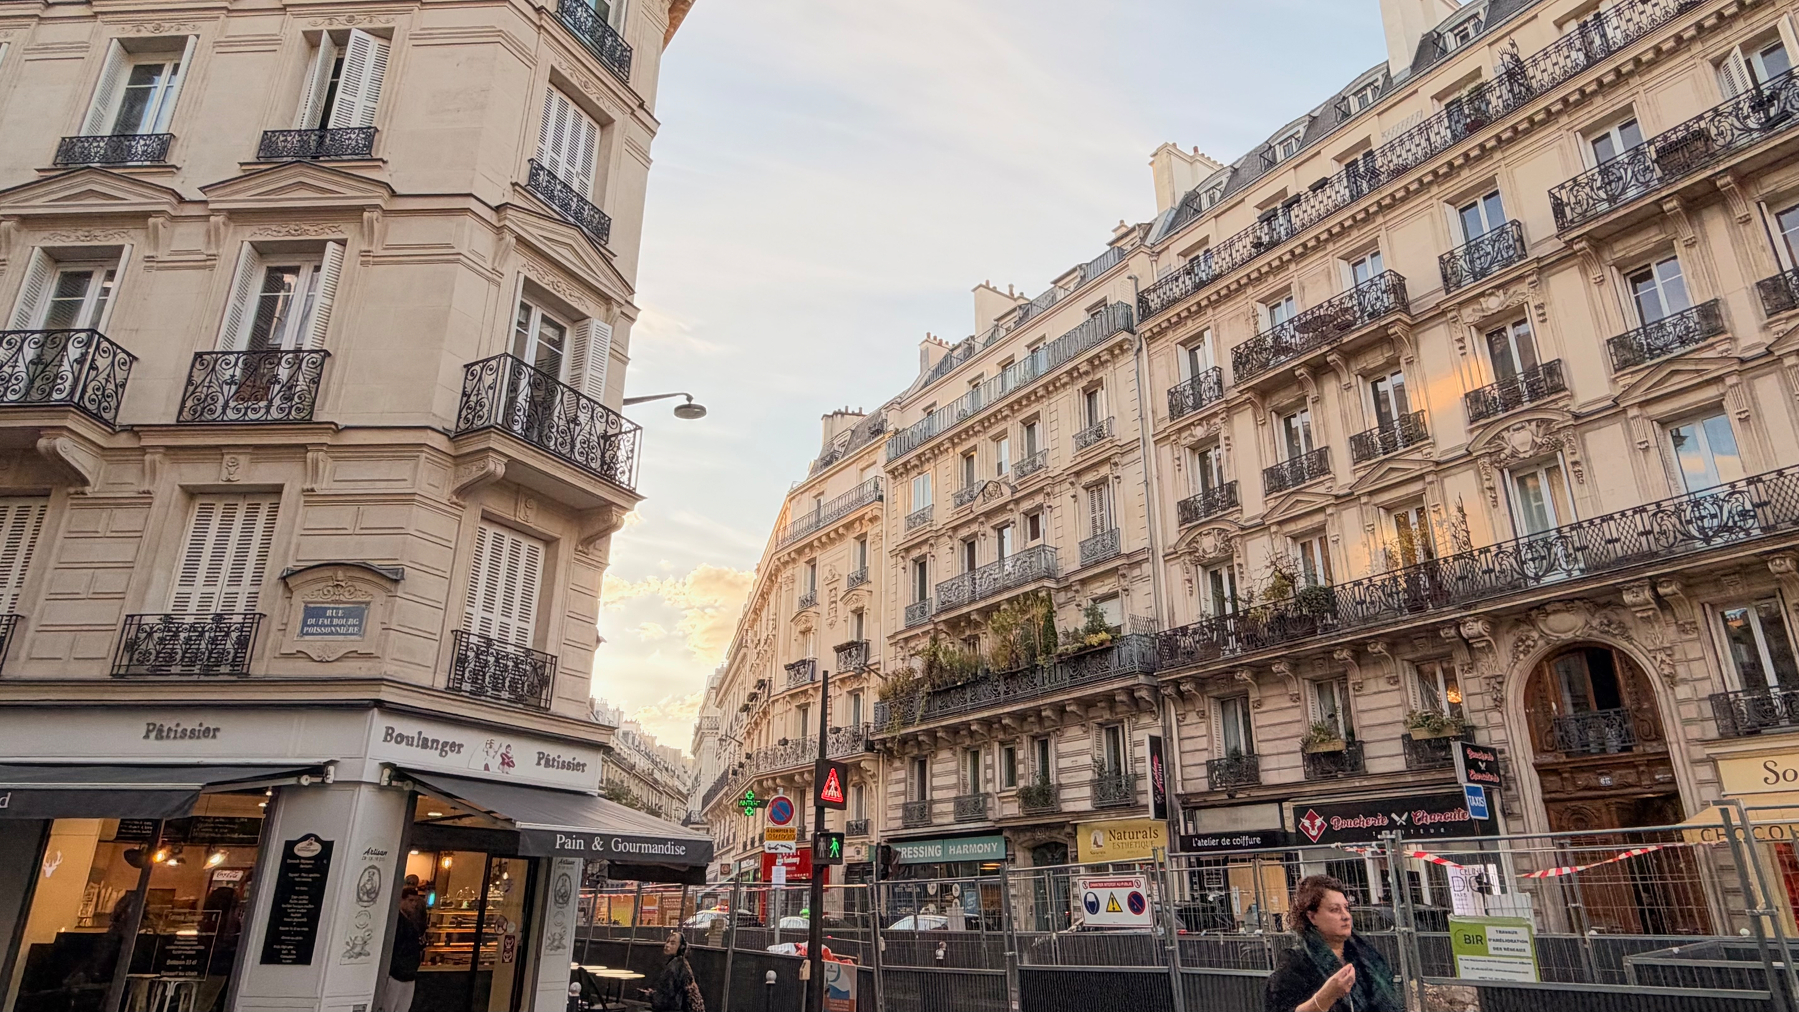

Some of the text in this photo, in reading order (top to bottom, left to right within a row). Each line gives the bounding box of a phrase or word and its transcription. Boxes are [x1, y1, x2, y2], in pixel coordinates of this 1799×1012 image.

[326, 609, 344, 617] RUE
[303, 624, 360, 633] POISSONNIÈRE
[142, 722, 221, 740] Pâtissier
[382, 726, 464, 757] Boulanger
[535, 751, 588, 773] Pâtissier
[1467, 795, 1485, 807] TAXIS
[1330, 813, 1389, 831] Boucherie
[1109, 826, 1159, 841] Naturals
[555, 834, 686, 855] Pain & Gourmandise
[1221, 837, 1231, 846] de
[1232, 835, 1262, 847] coiffure
[363, 847, 388, 856] Artisan
[948, 842, 998, 855] HARMONY
[1463, 934, 1484, 945] BIR
